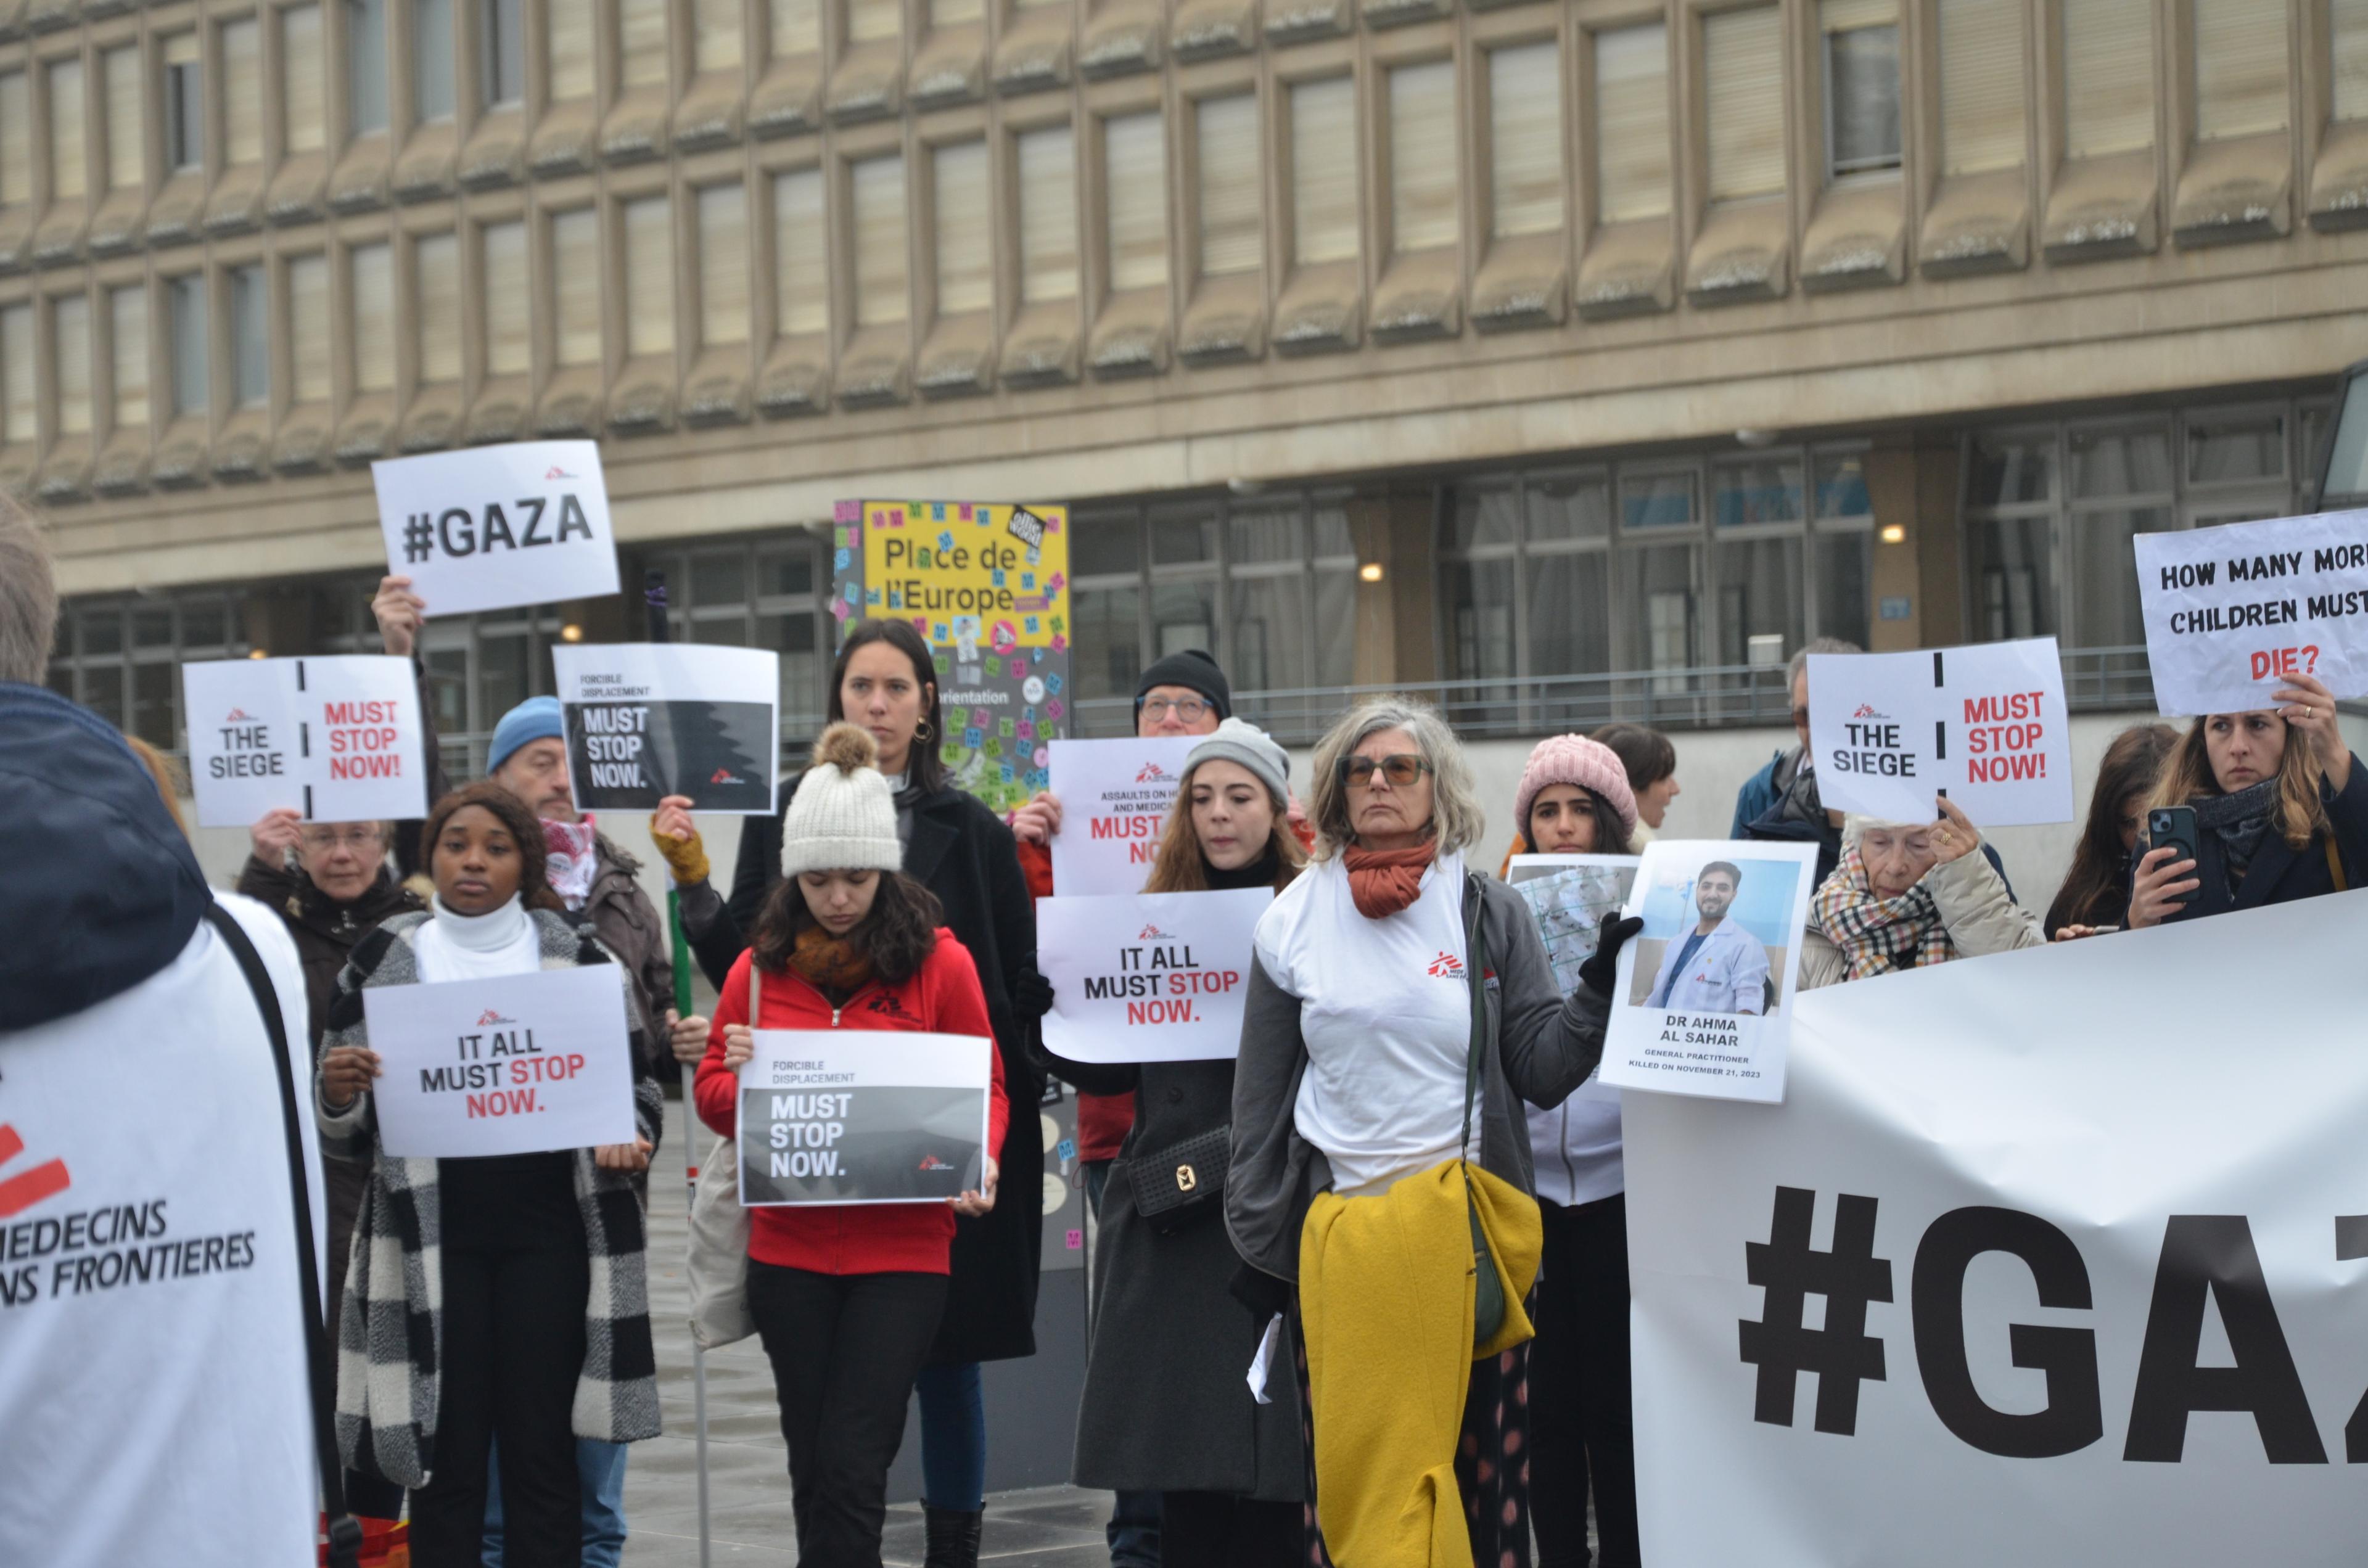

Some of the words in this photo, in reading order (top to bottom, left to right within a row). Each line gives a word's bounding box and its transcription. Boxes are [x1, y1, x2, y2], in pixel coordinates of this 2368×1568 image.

[403, 494, 593, 564] #GAZA
[980, 540, 1016, 570] de
[2161, 562, 2216, 590] HOW
[2228, 551, 2303, 582] MANY
[2314, 543, 2368, 573] MOR
[2171, 599, 2298, 634] CHILDREN
[2308, 590, 2368, 620] MUST
[2251, 645, 2319, 681] DIE?
[580, 674, 622, 684] FORCIBLE
[581, 686, 650, 697] DISPLACEMENT
[324, 701, 397, 724] MUST
[583, 707, 649, 734] MUST
[1963, 691, 2044, 724] MUST
[220, 726, 268, 750] THE
[329, 728, 397, 752] STOP
[586, 736, 643, 761] STOP
[1844, 723, 1900, 748] THE
[1968, 723, 2043, 753] STOP
[210, 752, 284, 779] SIEGE
[330, 754, 401, 780] NOW!
[590, 763, 649, 789] NOW.
[1833, 750, 1916, 778] SIEGE
[1968, 753, 2046, 784] NOW!
[1101, 790, 1150, 801] ASSAULTS
[1153, 790, 1166, 798] ON
[1114, 803, 1133, 813] AND
[1090, 816, 1162, 839] MUST
[1120, 948, 1143, 971] IT
[1151, 945, 1199, 969] ALL
[1085, 975, 1162, 999] MUST
[1168, 971, 1240, 995] STOP
[1127, 999, 1201, 1025] NOW.
[1666, 1015, 1687, 1027] DR
[1692, 1017, 1737, 1031] AHMA
[458, 1035, 483, 1060] IT
[490, 1029, 541, 1057] ALL
[1659, 1030, 1680, 1042] AL
[1685, 1032, 1738, 1046] SAHAR
[773, 1061, 824, 1071] FORCIBLE
[1629, 1060, 1659, 1070] KILLED
[1661, 1063, 1674, 1071] ON
[1677, 1065, 1724, 1076] NOVEMBER
[1725, 1070, 1738, 1078] 21,
[1741, 1071, 1761, 1079] 2023
[1645, 1049, 1684, 1059] GENERAL
[1687, 1053, 1749, 1064] PRACTITIONER
[420, 1062, 502, 1093] MUST
[510, 1054, 585, 1085] STOP
[772, 1073, 855, 1084] DISPLACEMENT
[466, 1088, 545, 1119] NOW.
[770, 1093, 853, 1120] MUST
[770, 1122, 843, 1149] STOP
[770, 1151, 846, 1178] NOW.
[50, 1230, 255, 1299] FRONTIERES
[1737, 1184, 2368, 1465] #GA
